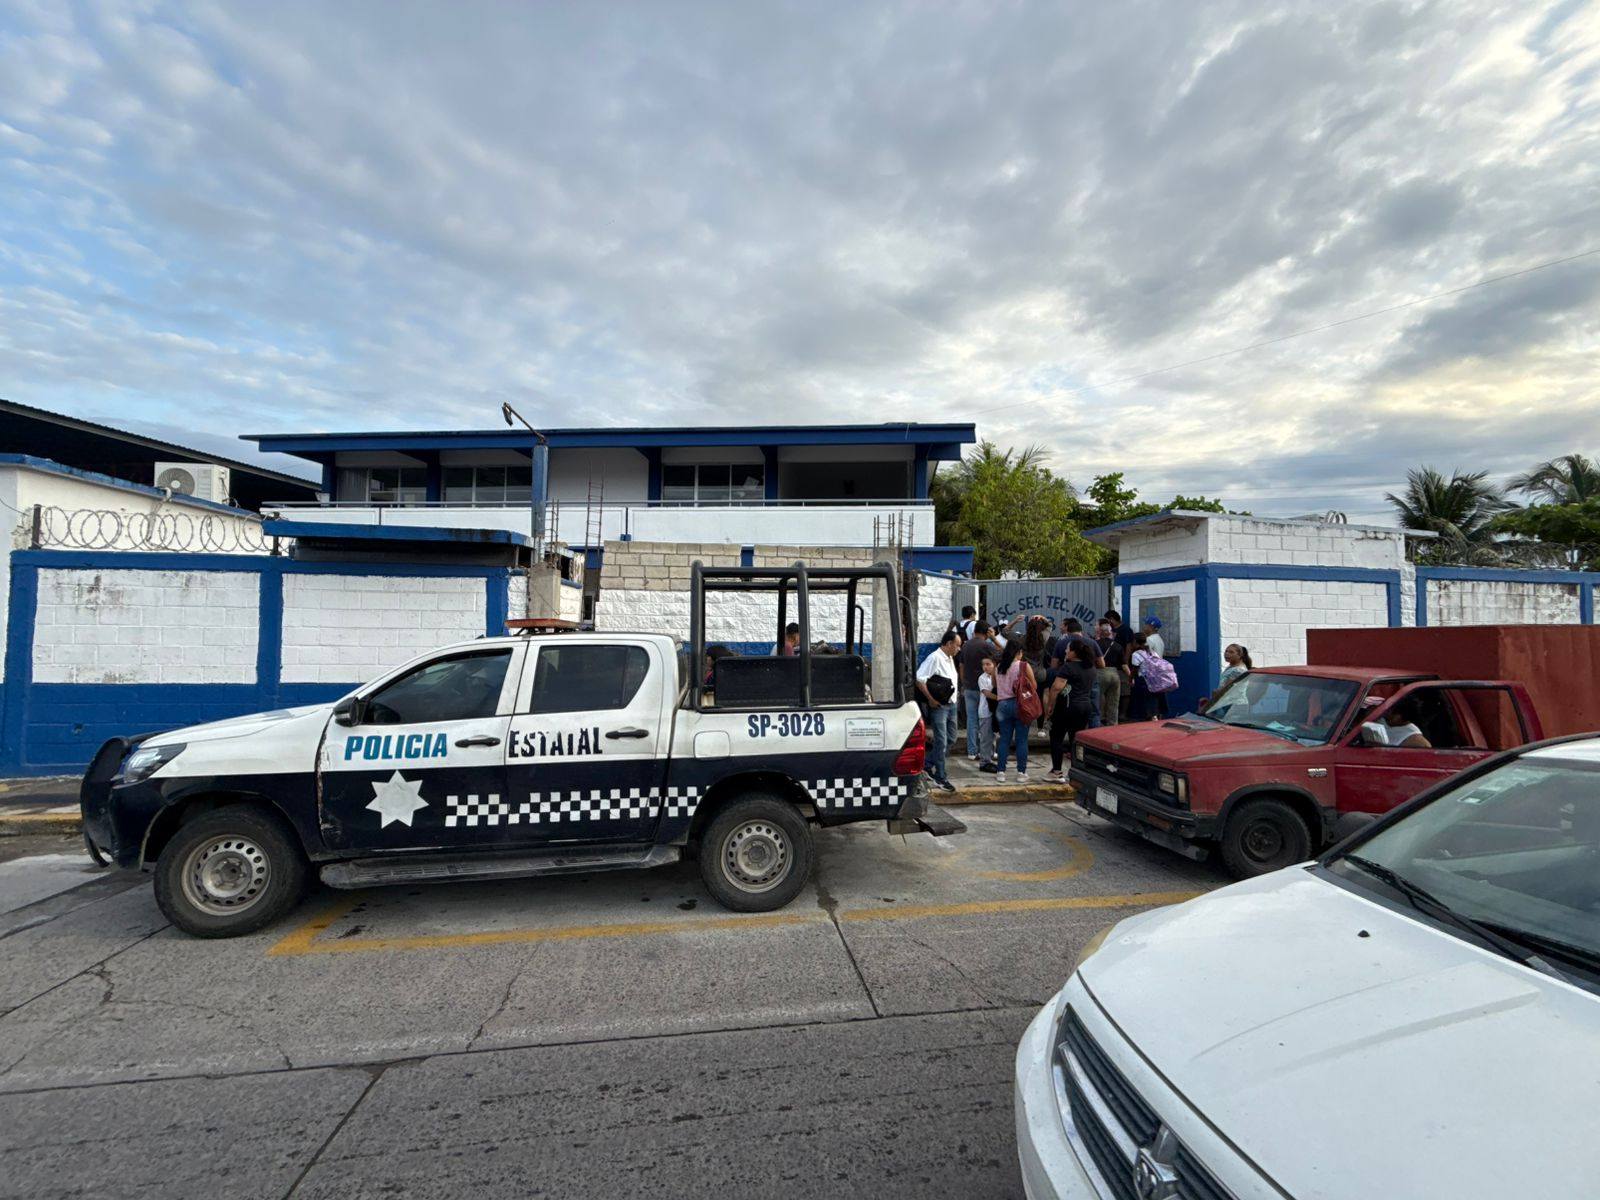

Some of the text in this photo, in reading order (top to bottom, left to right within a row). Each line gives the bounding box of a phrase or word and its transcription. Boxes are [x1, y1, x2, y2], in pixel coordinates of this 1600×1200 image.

[1018, 596, 1043, 611] SEC.
[1047, 595, 1069, 613] TEC.
[1072, 603, 1096, 626] IND.
[748, 713, 825, 737] SP-3028
[344, 733, 448, 761] POLICIA
